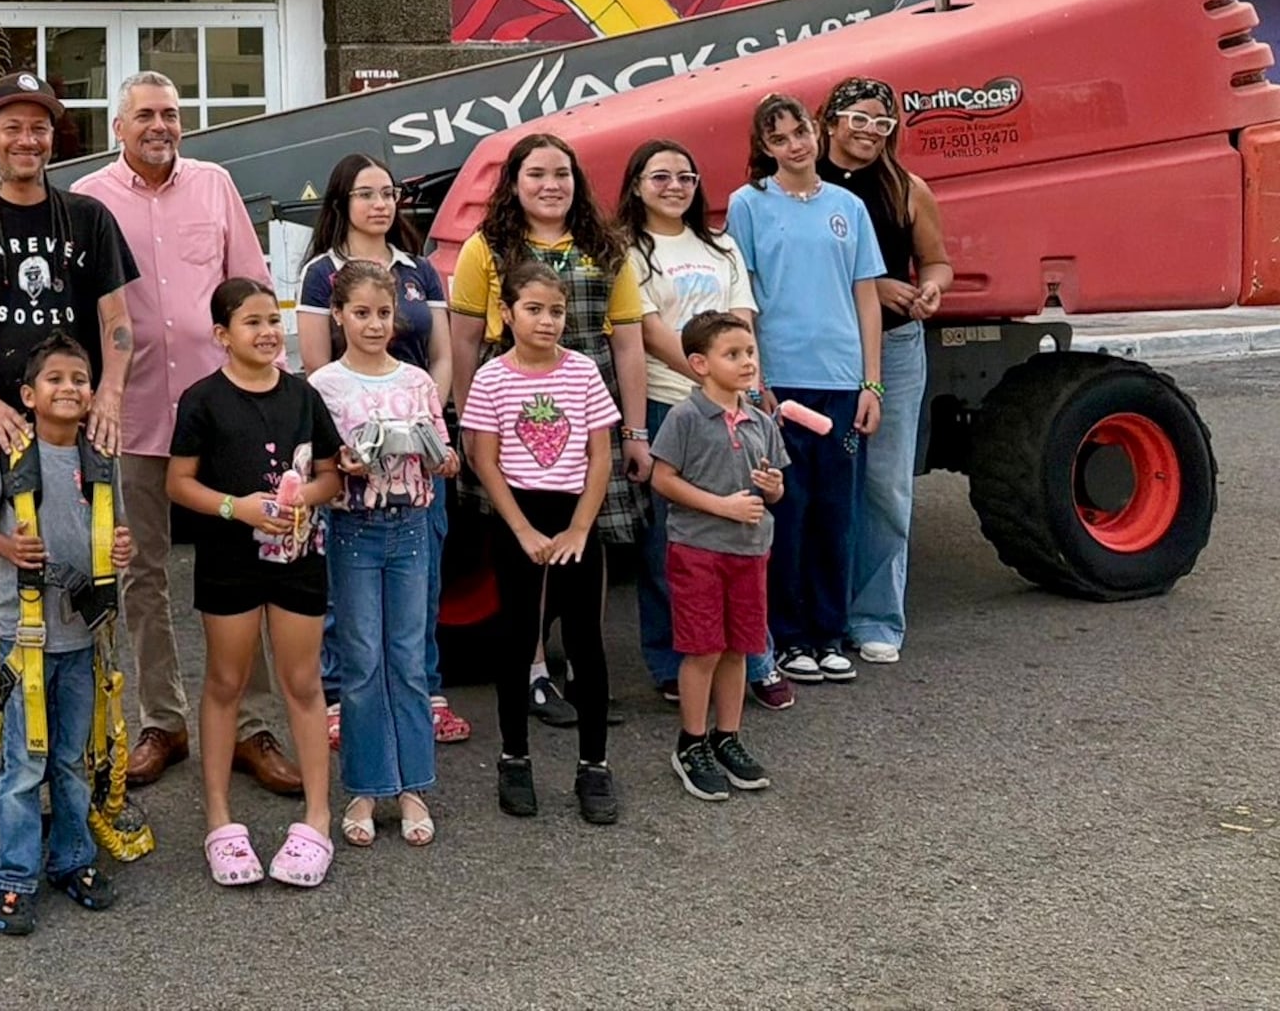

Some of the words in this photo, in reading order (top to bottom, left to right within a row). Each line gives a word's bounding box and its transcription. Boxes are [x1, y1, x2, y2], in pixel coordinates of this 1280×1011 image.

[354, 69, 400, 79] ENTRADA
[388, 43, 717, 154] SKYJACK
[903, 83, 1018, 111] NorthCoast
[920, 129, 1019, 151] 787-501-9470
